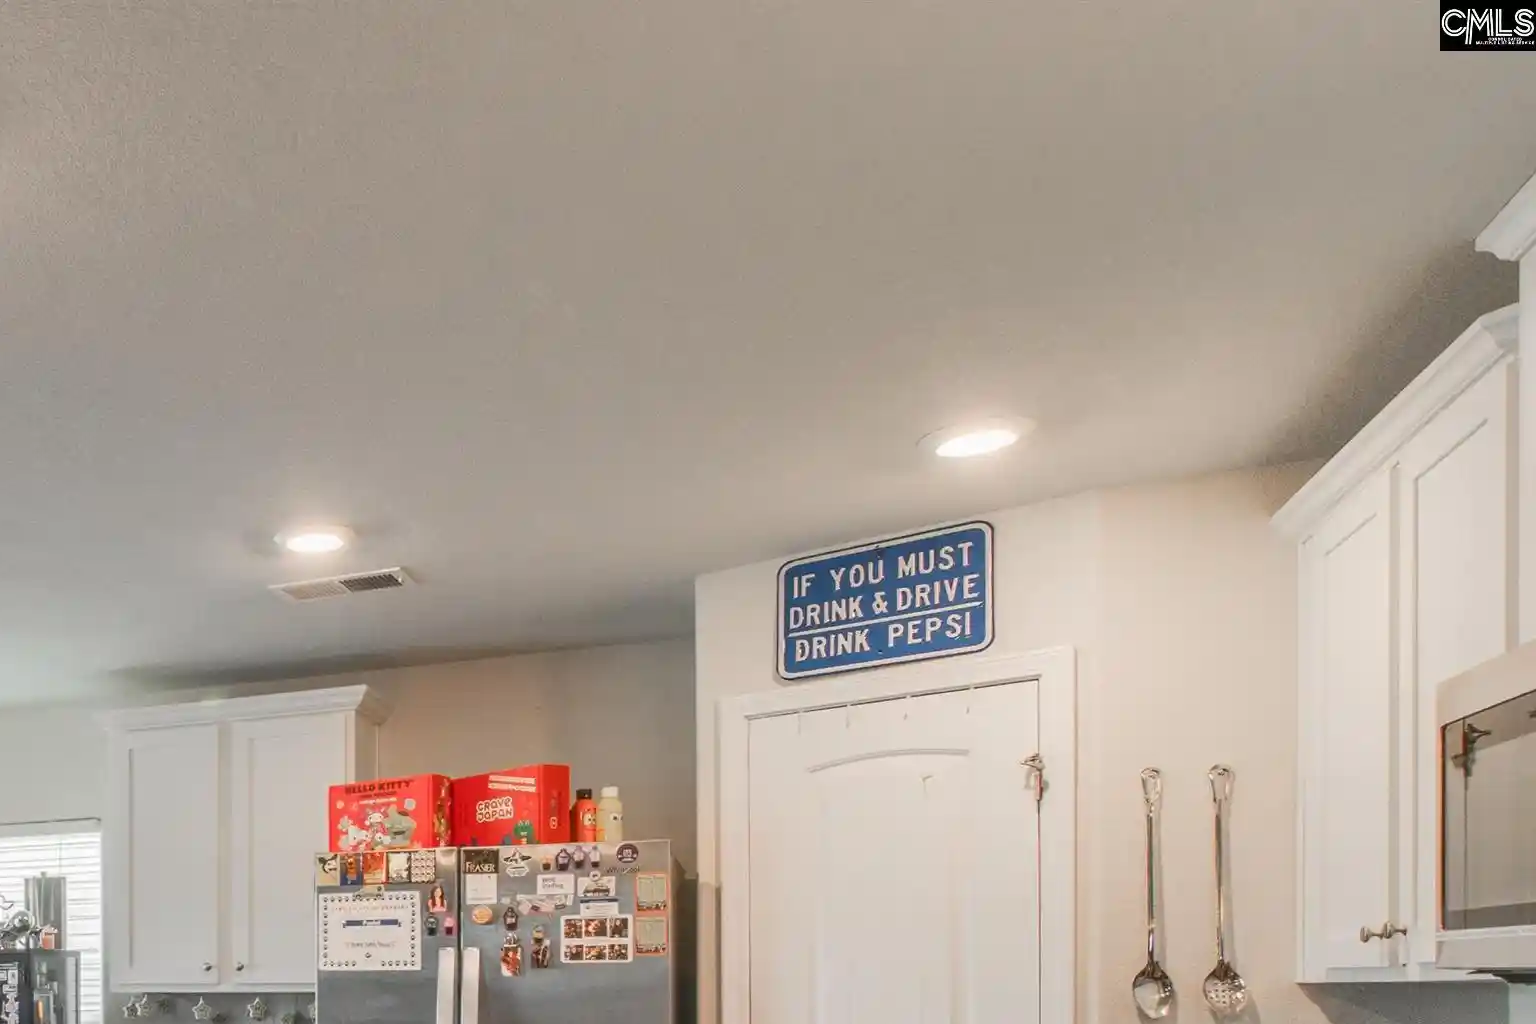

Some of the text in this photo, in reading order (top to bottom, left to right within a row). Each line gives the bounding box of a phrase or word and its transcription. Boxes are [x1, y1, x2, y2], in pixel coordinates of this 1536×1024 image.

[793, 541, 974, 599] IF YOU MUST
[789, 574, 980, 630] DRINK & DRIVE
[795, 611, 973, 662] DRINK PEPSI
[345, 783, 376, 796] HELLO
[377, 780, 411, 791] KITTY
[465, 861, 496, 873] FRASIER
